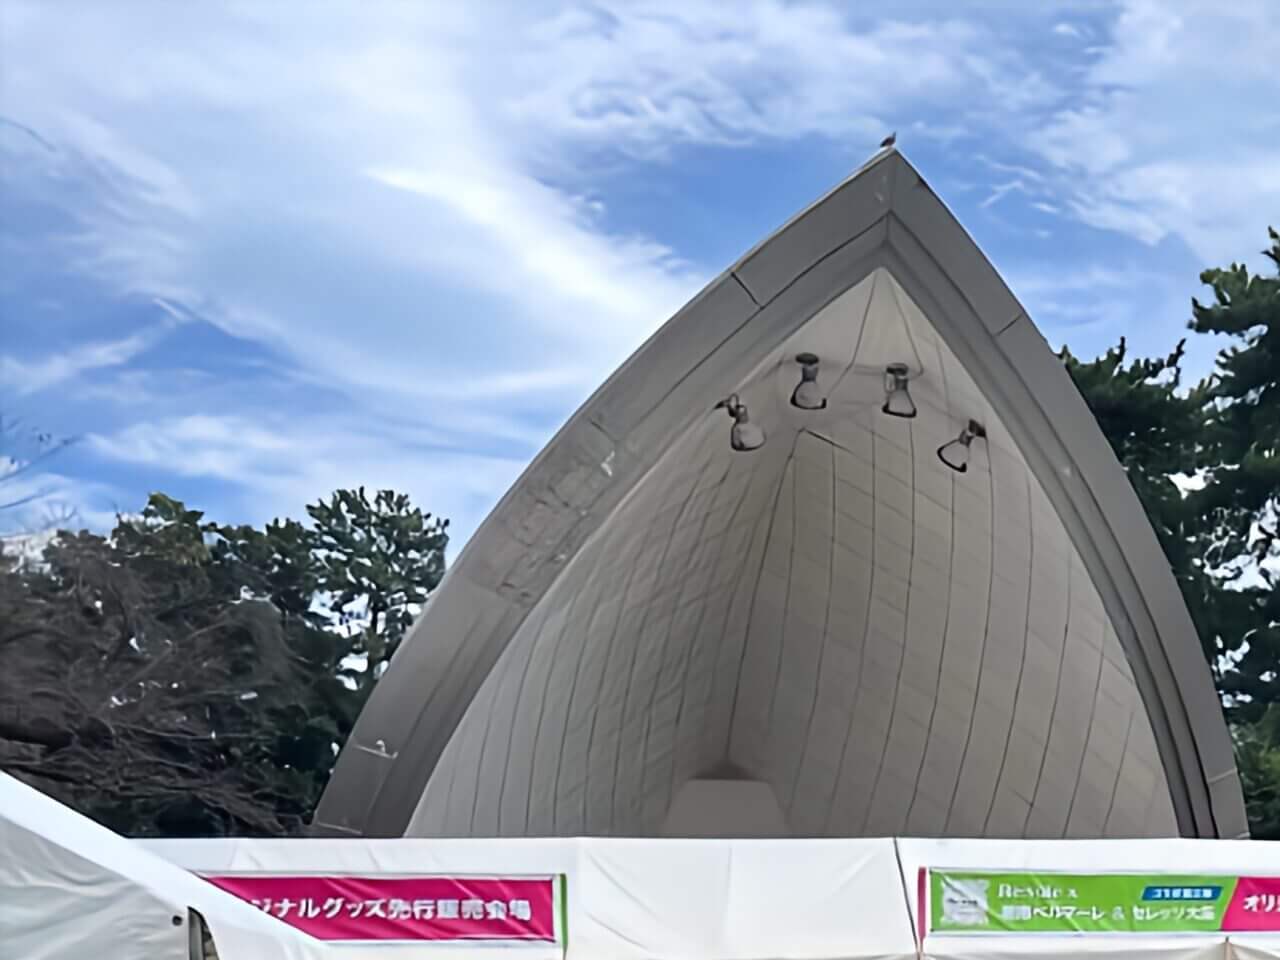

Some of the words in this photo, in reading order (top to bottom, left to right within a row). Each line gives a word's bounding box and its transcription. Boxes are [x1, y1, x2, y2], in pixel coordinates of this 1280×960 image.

[1002, 904, 1105, 921] ベルマーレ
